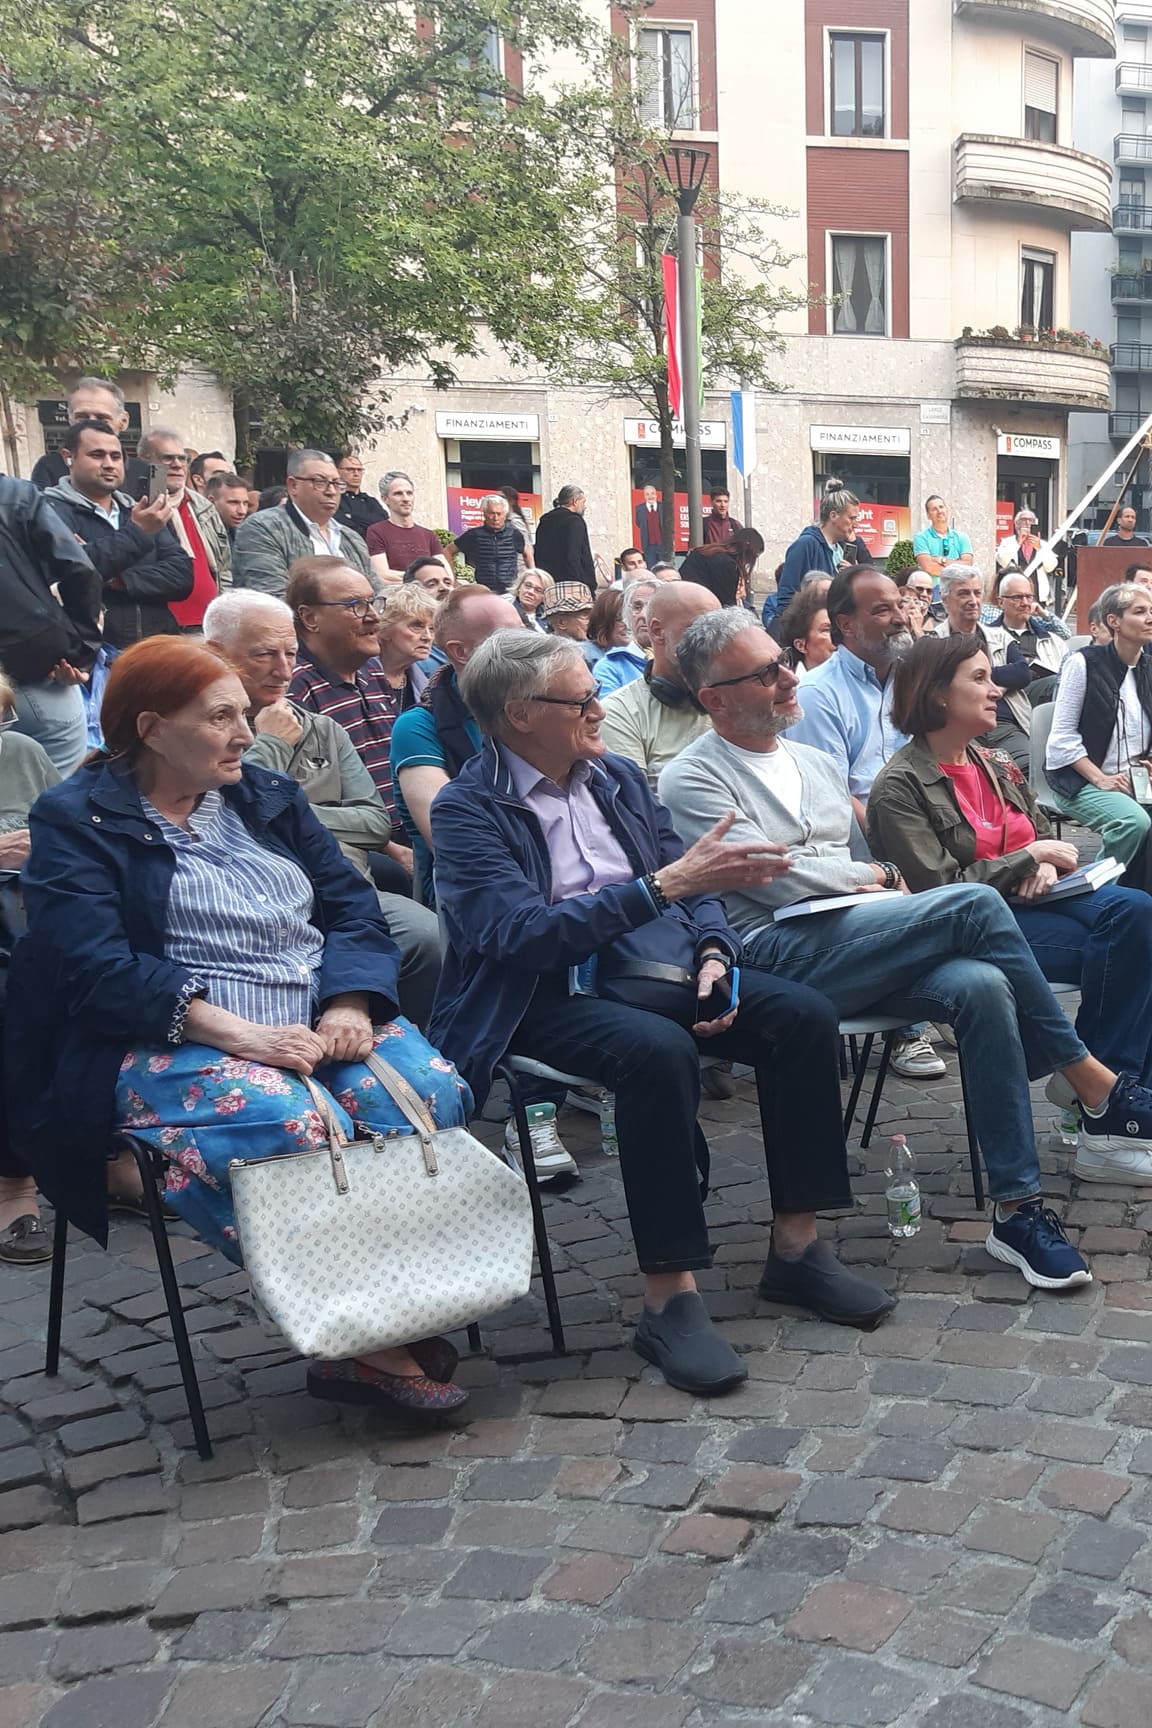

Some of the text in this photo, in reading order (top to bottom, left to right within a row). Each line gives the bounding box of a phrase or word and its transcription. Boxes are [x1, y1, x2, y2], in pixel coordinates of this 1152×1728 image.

[445, 418, 529, 430] FINANZIAMENTI
[819, 432, 901, 444] FINANZIAMENTI
[1013, 437, 1053, 450] COMPASS
[459, 496, 483, 509] Hey
[856, 509, 874, 522] ght
